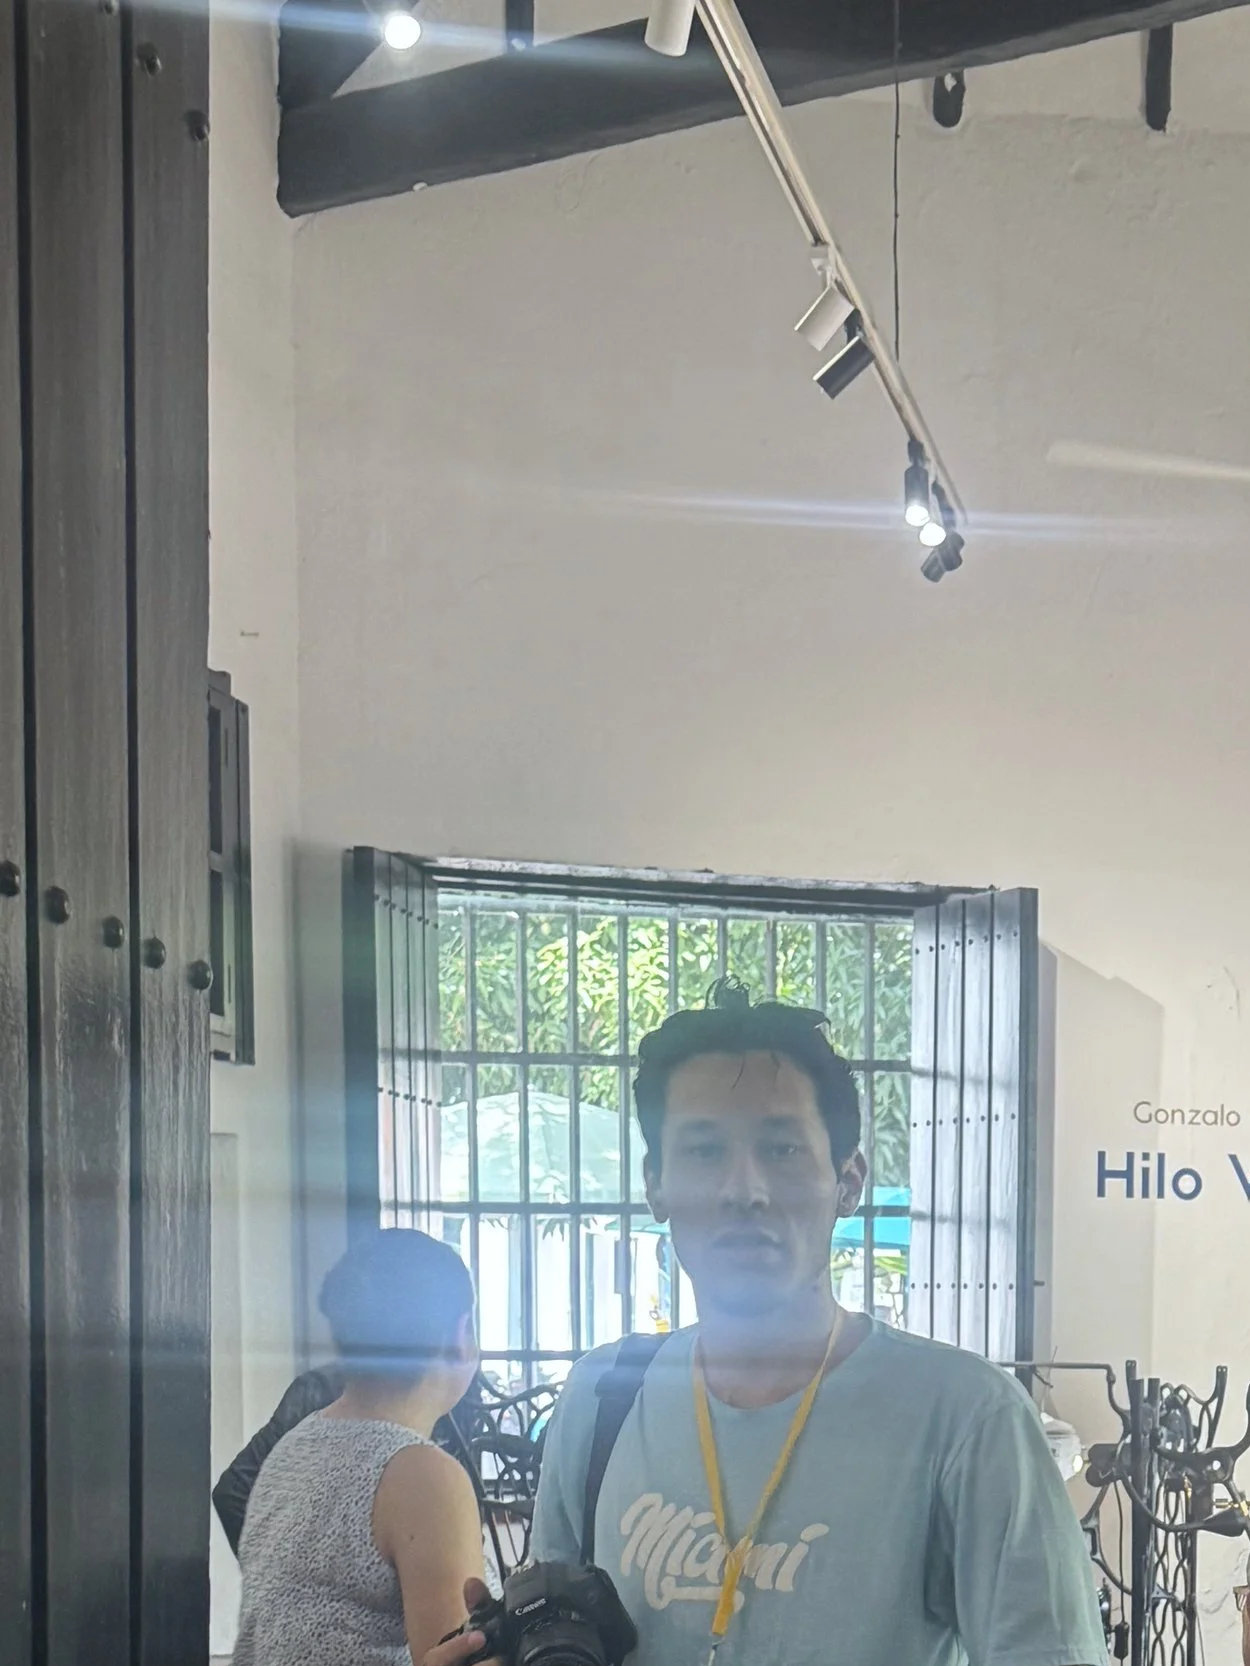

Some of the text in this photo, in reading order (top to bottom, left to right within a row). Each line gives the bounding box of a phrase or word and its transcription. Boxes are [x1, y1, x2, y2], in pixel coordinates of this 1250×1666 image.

[1133, 1101, 1241, 1127] Gonzalo
[1097, 1150, 1203, 1201] Hilo
[620, 1492, 830, 1614] Miami
